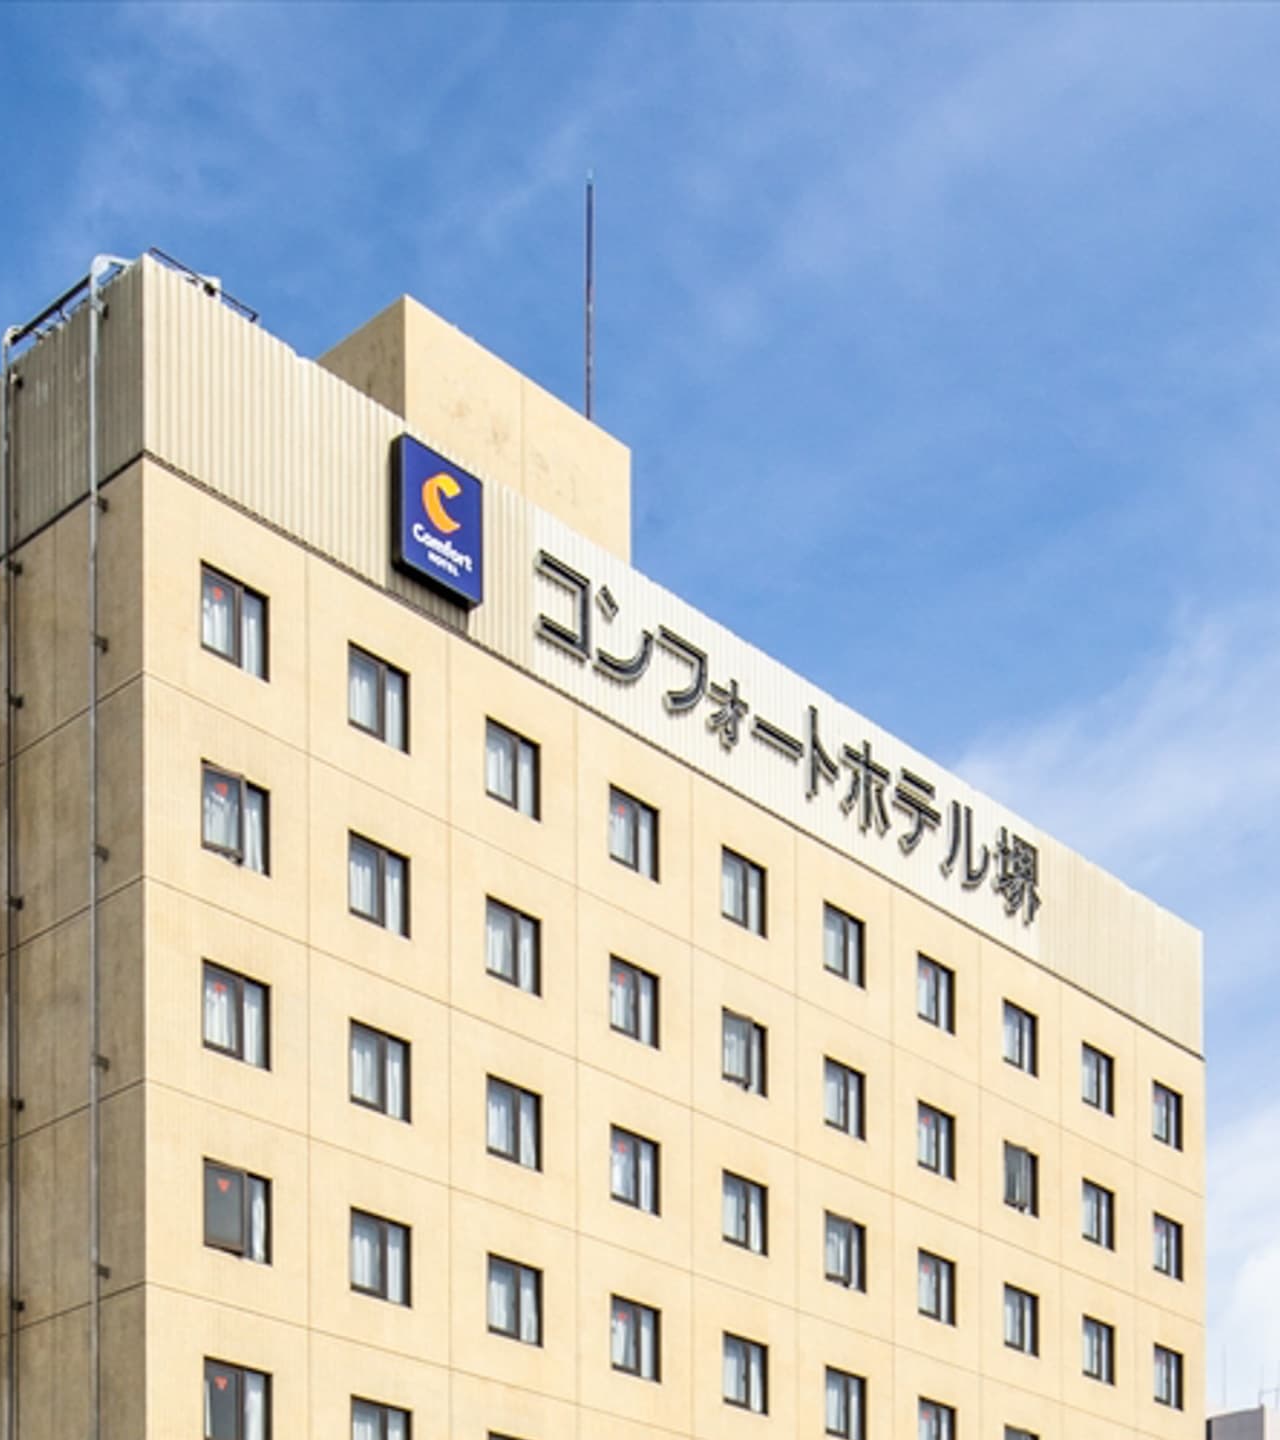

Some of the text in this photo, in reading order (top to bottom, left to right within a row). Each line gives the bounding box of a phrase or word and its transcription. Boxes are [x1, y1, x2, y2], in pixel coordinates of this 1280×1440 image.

[412, 522, 473, 572] Comfort
[534, 549, 1042, 926] コンフォートホテル堺
